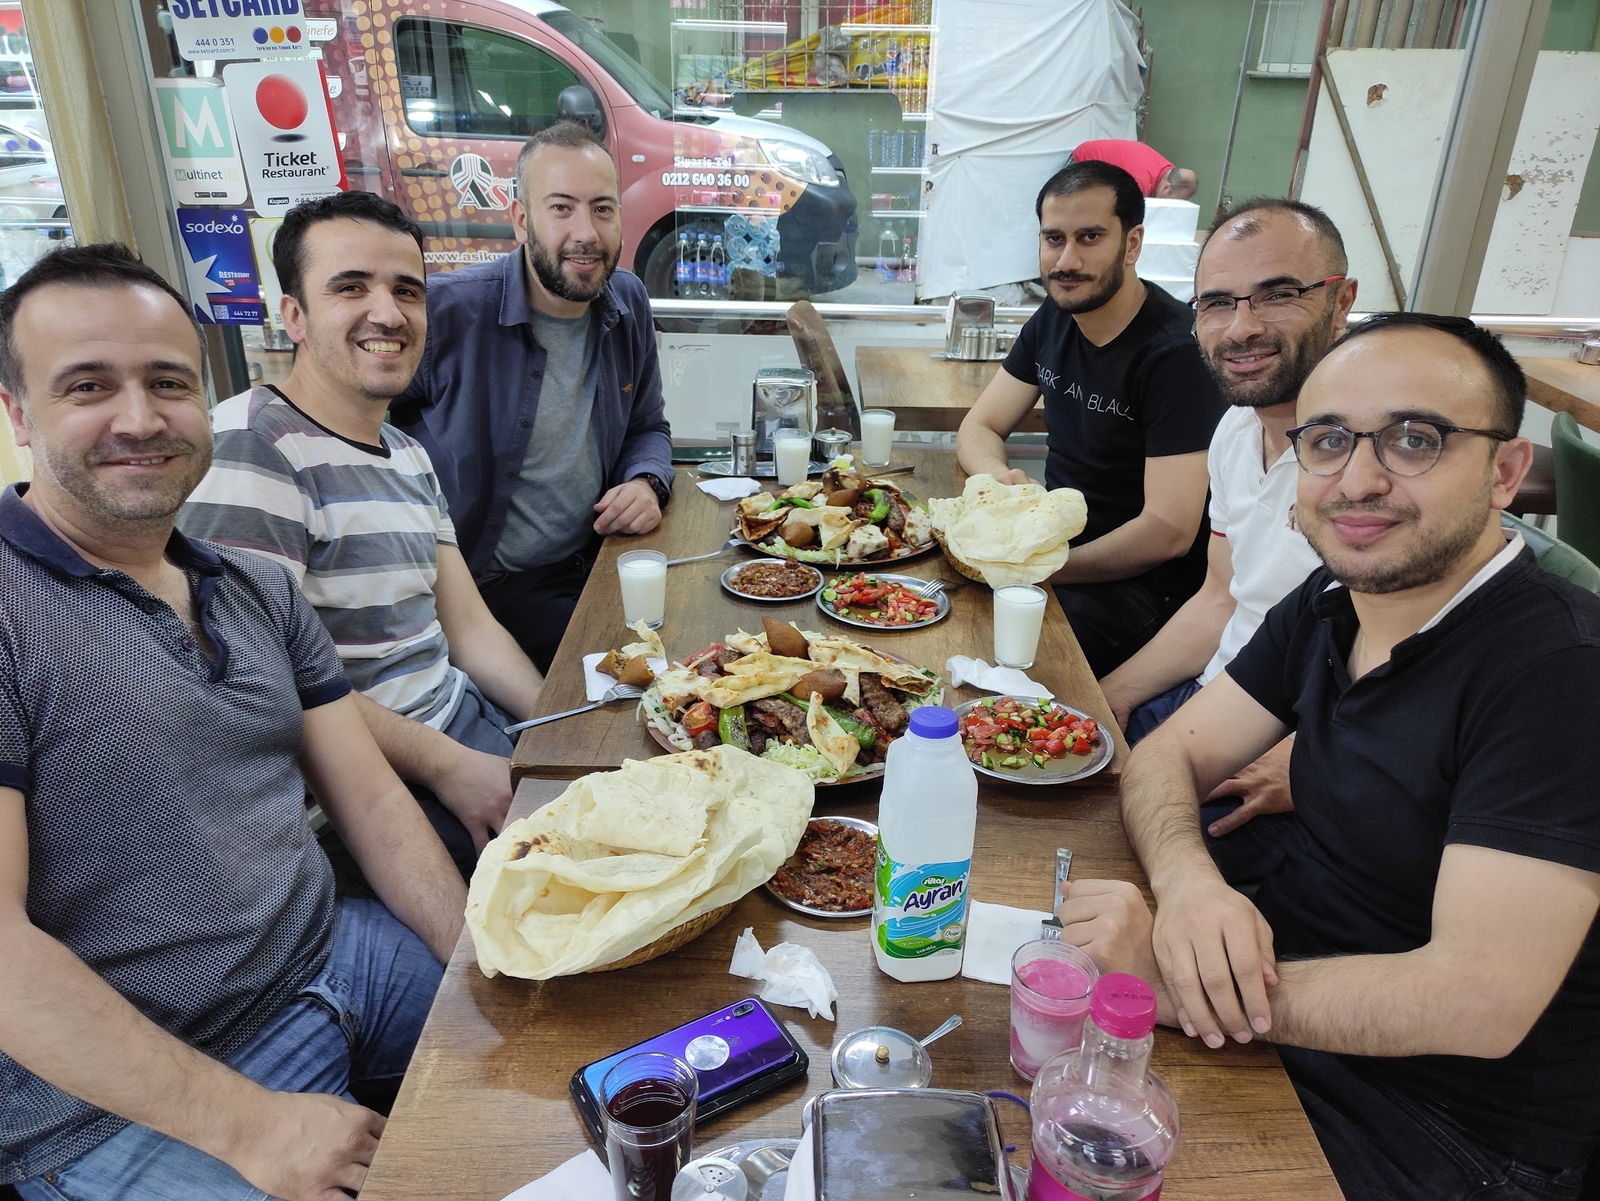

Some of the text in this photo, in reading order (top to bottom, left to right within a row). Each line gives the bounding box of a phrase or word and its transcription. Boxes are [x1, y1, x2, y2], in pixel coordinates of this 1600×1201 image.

[195, 38, 235, 47] 444 0 351
[264, 152, 317, 167] Ticket
[175, 168, 223, 181] Multinet
[262, 167, 327, 179] Restaurant
[662, 173, 750, 187] 0212 640 36 00
[185, 220, 244, 234] sodexo
[903, 880, 964, 912] Ayran
